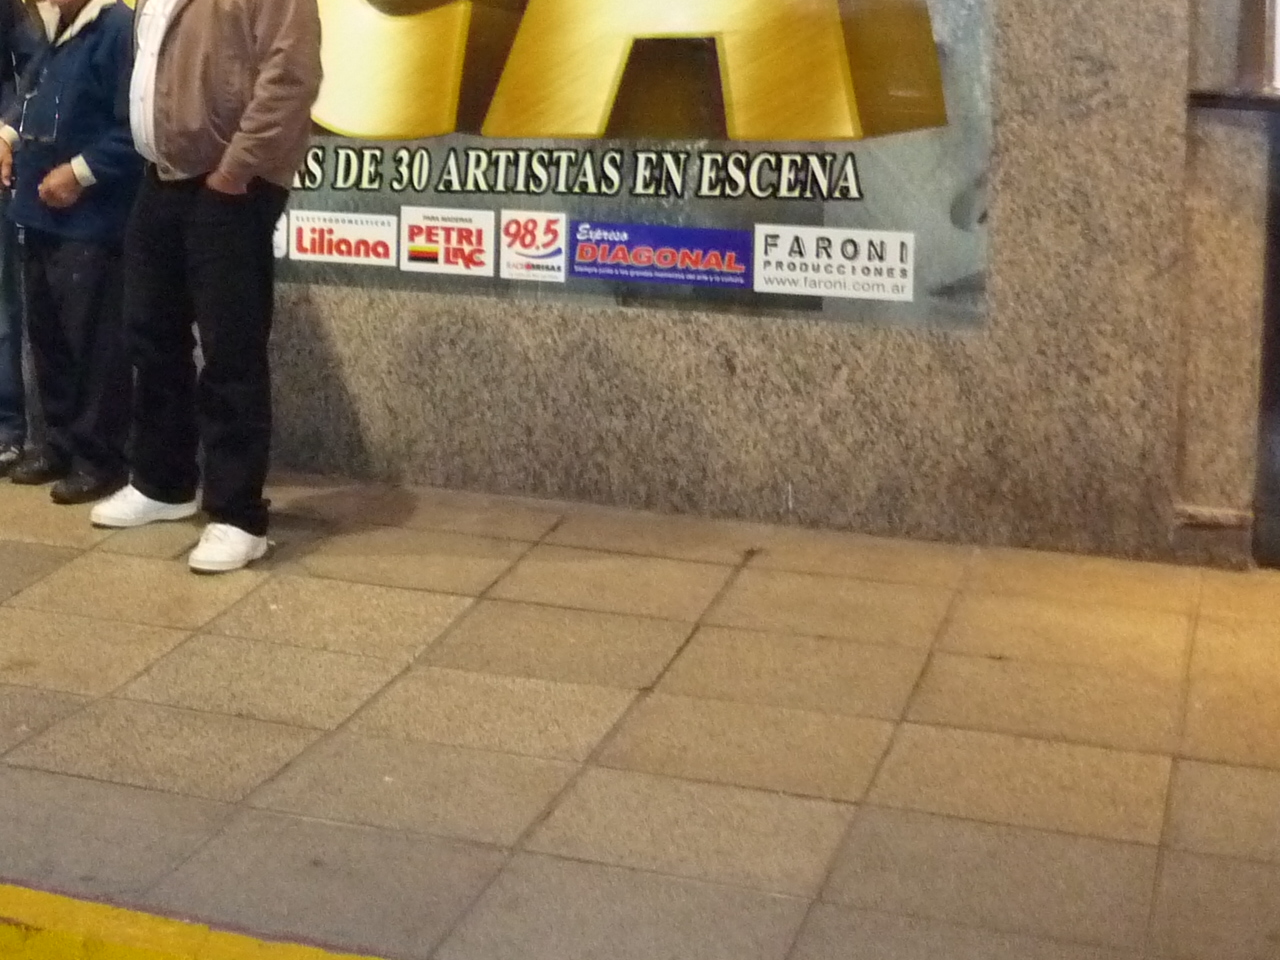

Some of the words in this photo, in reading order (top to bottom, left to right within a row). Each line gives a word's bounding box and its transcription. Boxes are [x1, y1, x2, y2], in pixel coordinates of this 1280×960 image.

[333, 146, 382, 191] DE
[390, 146, 431, 192] 30
[435, 147, 621, 196] ARTISTAS
[632, 149, 687, 198] EN
[697, 150, 863, 200] ESCENA
[295, 226, 391, 260] Liliana
[408, 224, 484, 248] PETRI
[503, 218, 560, 250] 98.5
[763, 233, 909, 265] FARONI
[575, 241, 747, 274] DIAGONAL
[763, 260, 909, 279] PRODUCCIONES
[763, 276, 907, 295] www.faroni.com.ar
